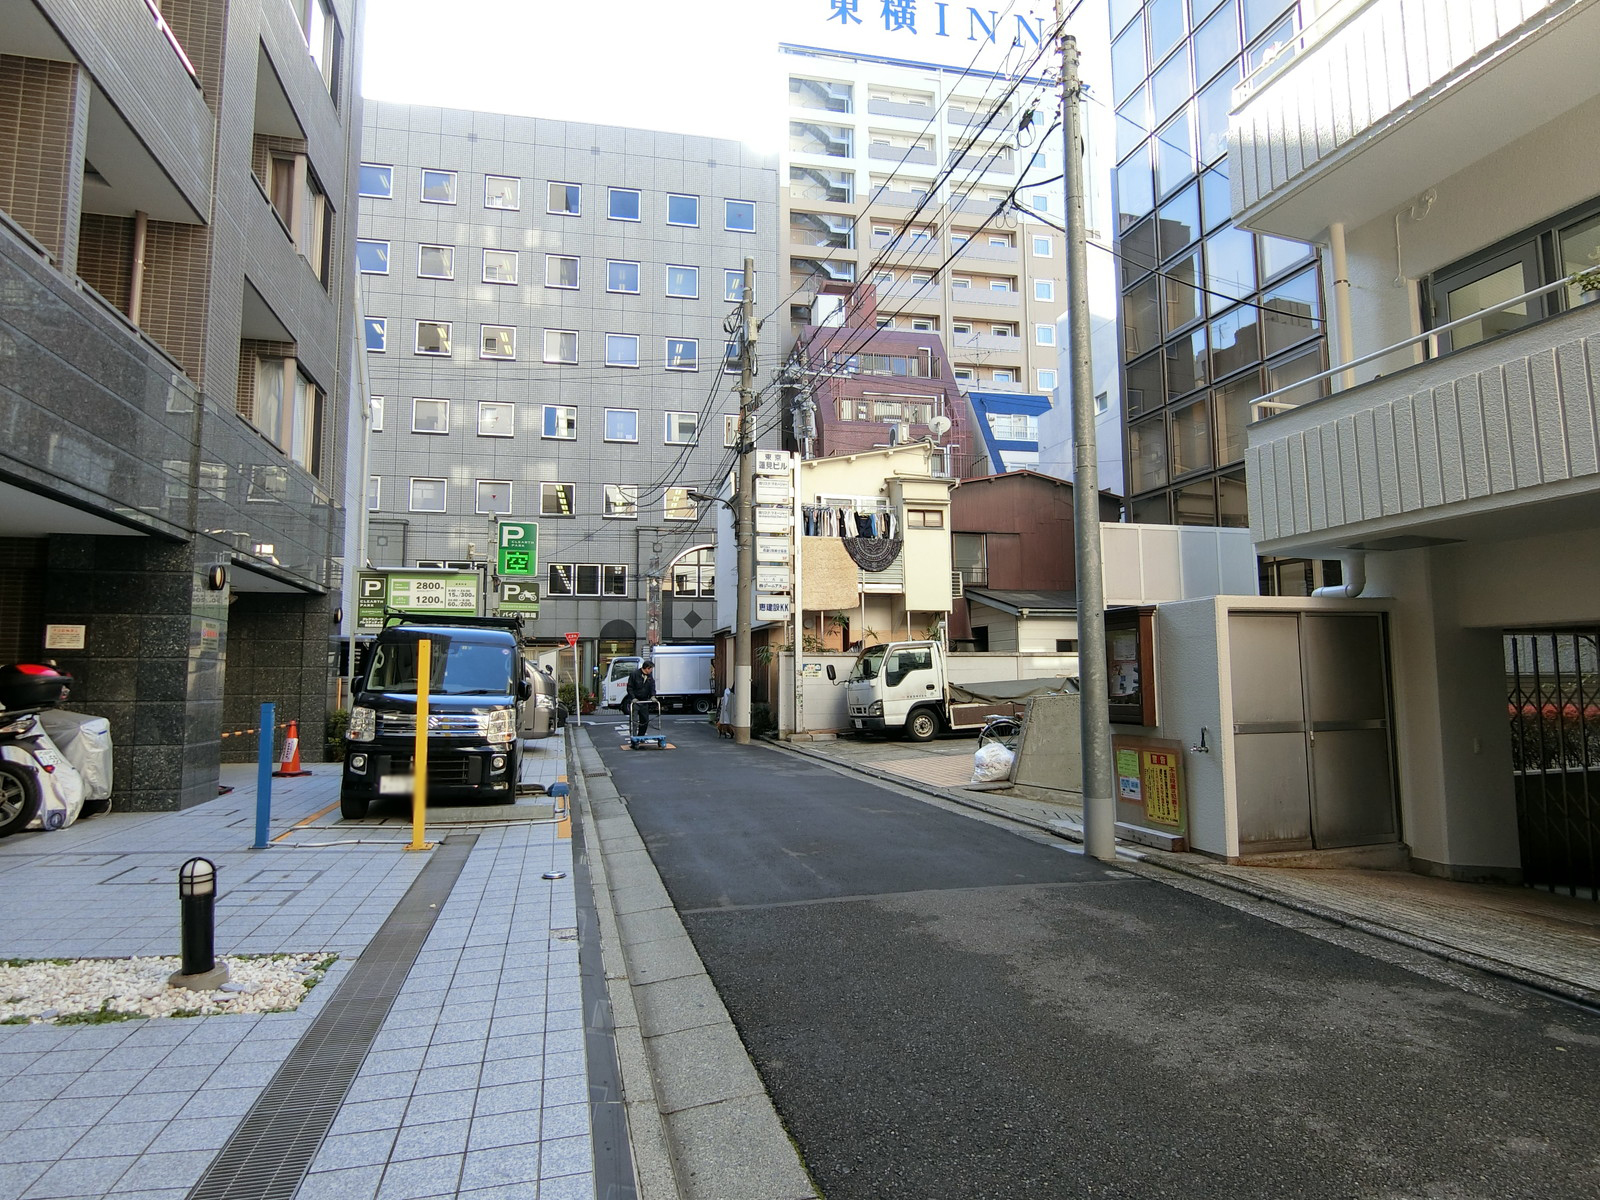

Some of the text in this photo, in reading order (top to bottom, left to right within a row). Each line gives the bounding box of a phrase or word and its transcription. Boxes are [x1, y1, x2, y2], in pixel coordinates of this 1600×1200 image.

[501, 526, 525, 548] P
[506, 551, 529, 573] 空
[364, 580, 382, 596] P
[503, 584, 521, 601] P
